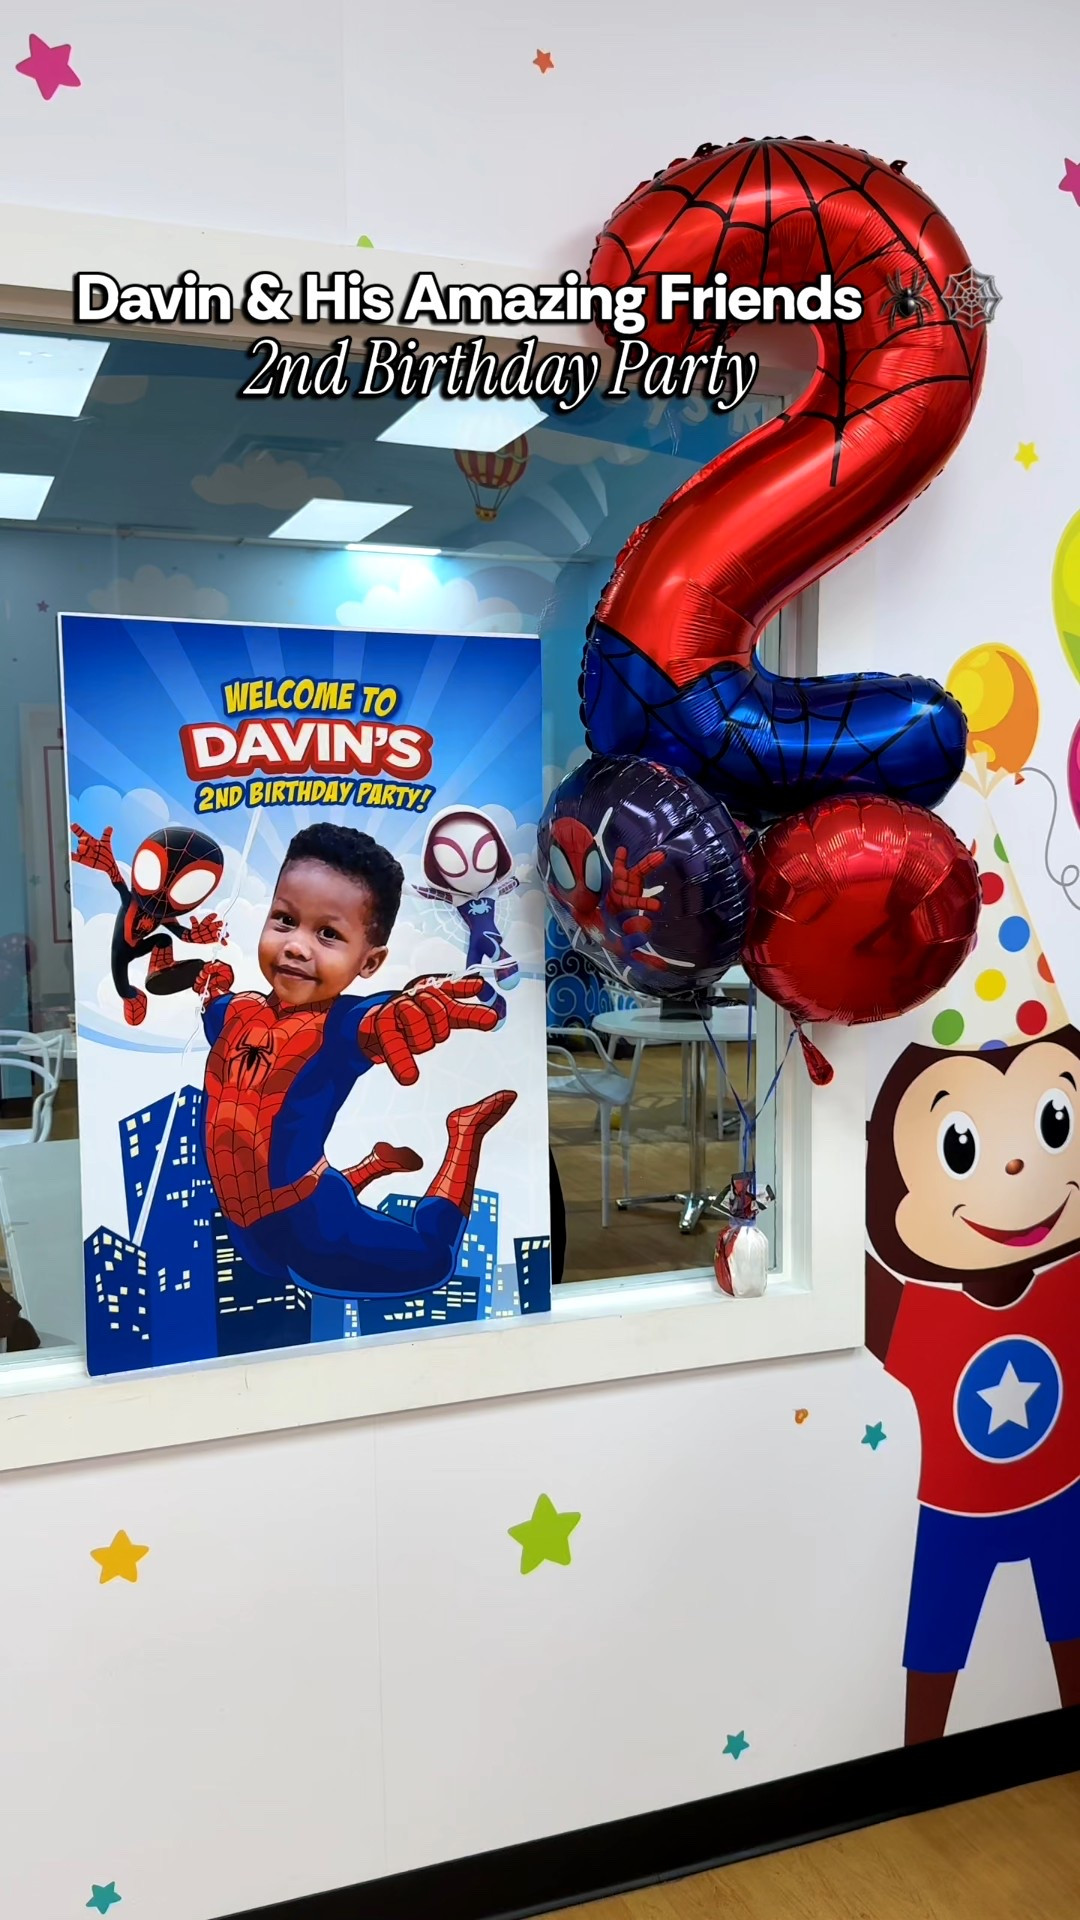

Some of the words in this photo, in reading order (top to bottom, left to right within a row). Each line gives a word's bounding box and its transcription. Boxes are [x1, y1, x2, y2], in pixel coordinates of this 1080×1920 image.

[224, 678, 355, 714] WELCOME
[362, 686, 397, 718] TO
[190, 722, 422, 769] DAVIN'S
[198, 786, 243, 812] 2ND
[249, 780, 353, 805] BIRTHDAY
[356, 782, 430, 811] PARTY!
